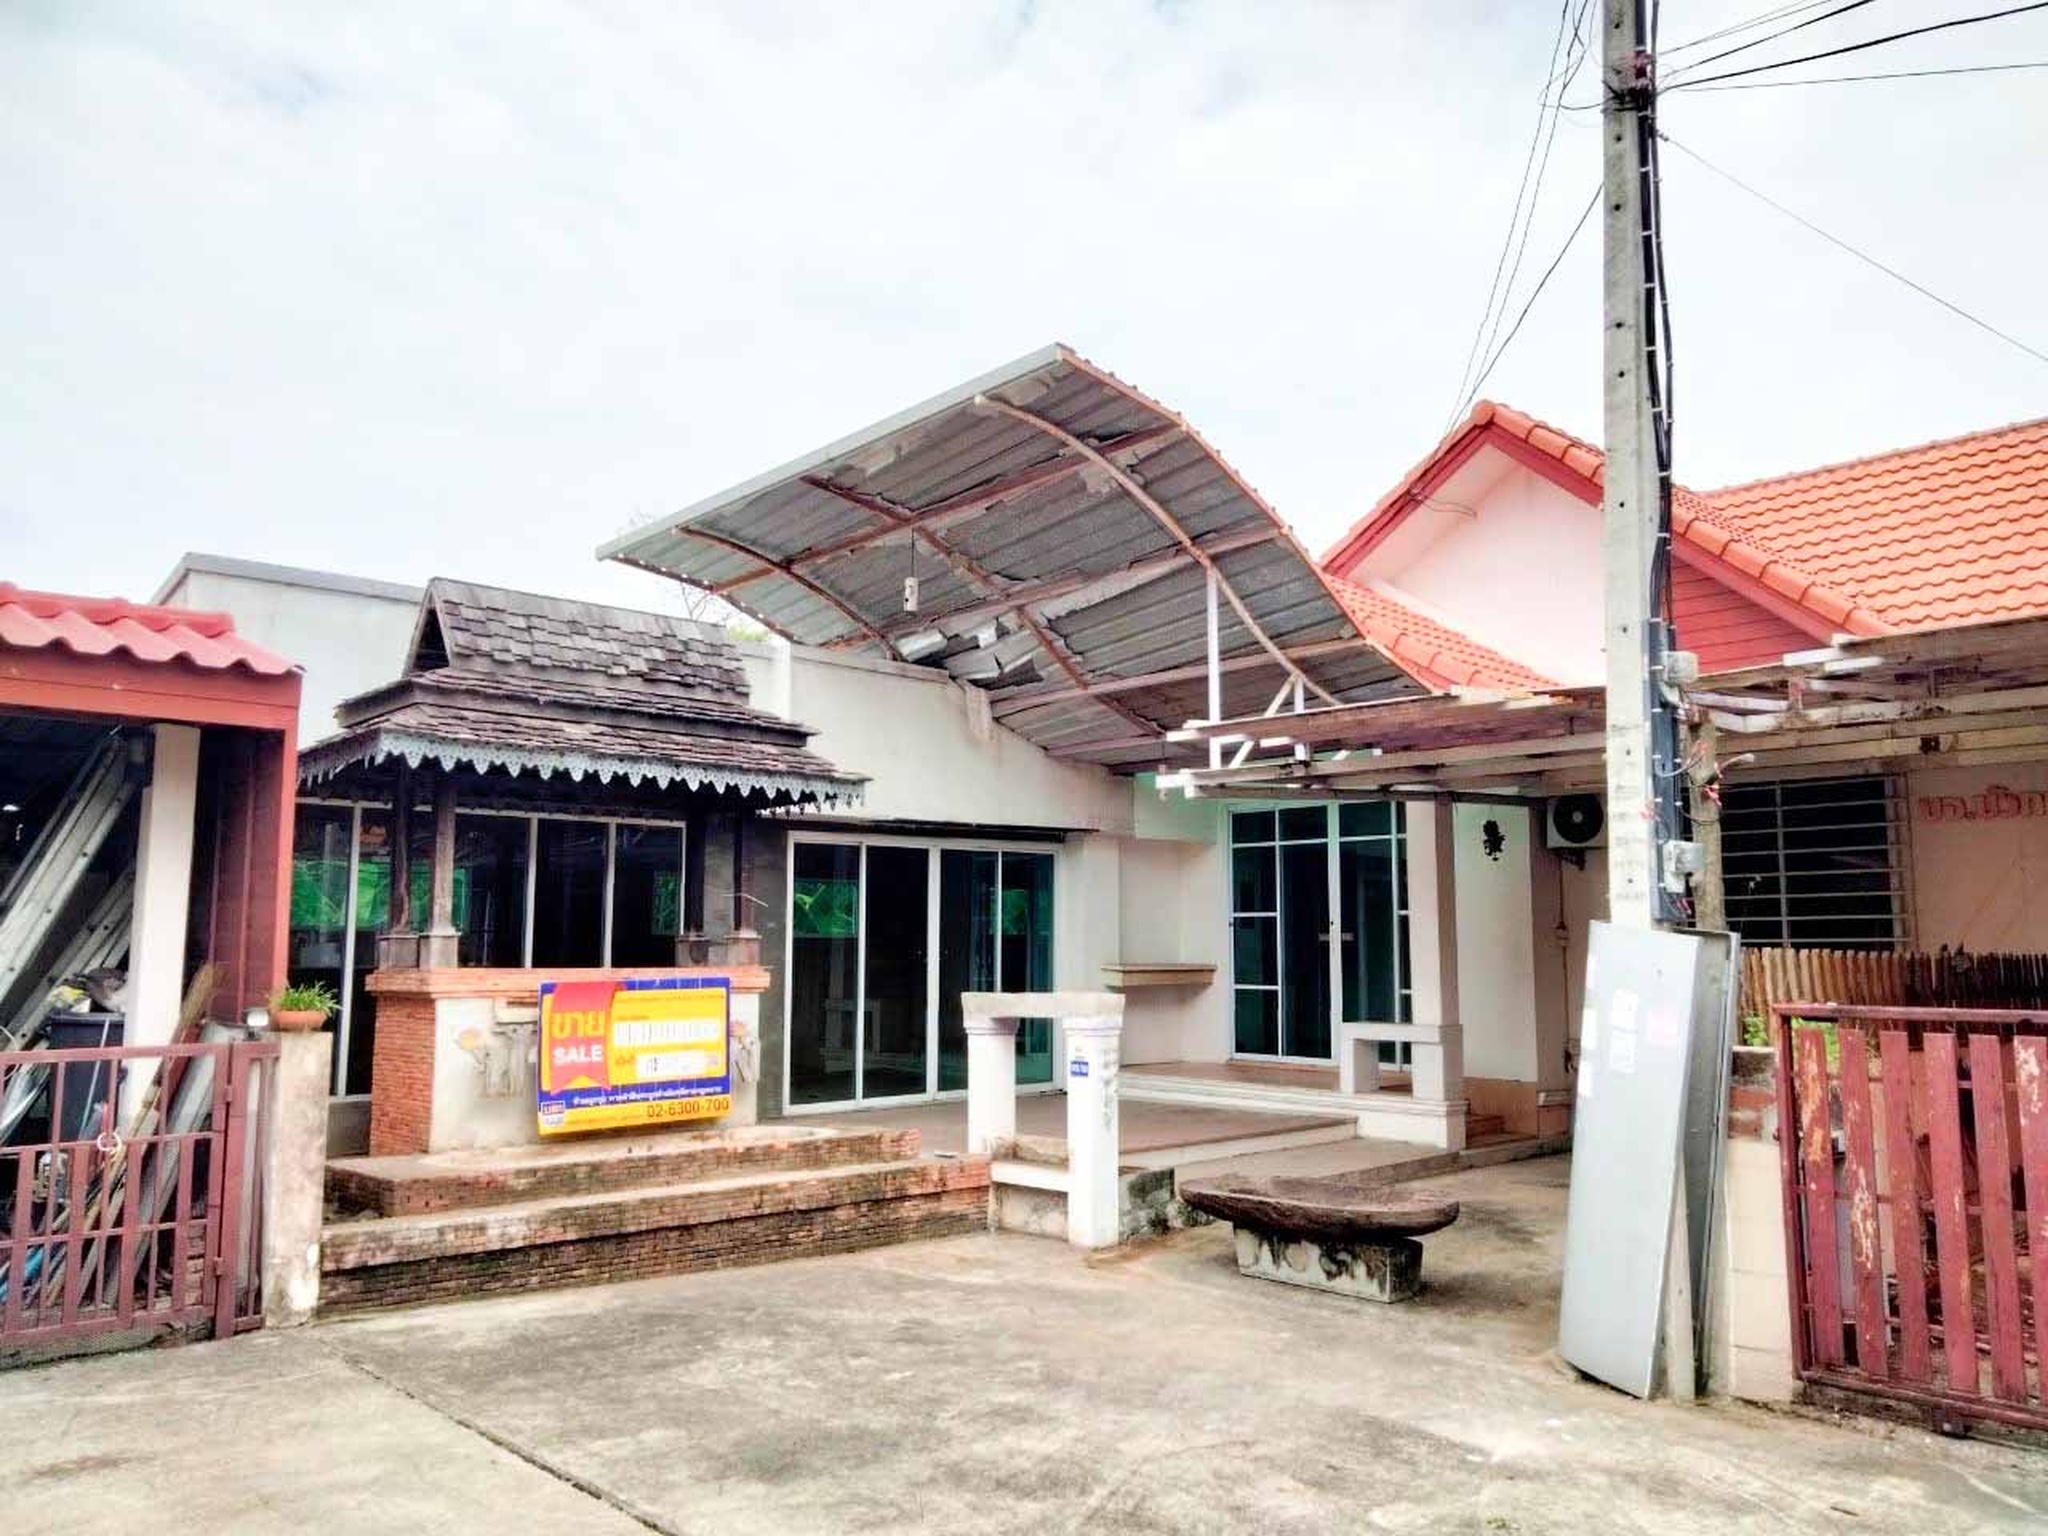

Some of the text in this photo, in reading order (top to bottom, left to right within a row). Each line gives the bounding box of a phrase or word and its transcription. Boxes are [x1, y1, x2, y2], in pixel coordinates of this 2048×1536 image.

[552, 1010, 606, 1039] ขาย
[553, 1044, 604, 1066] SALE
[646, 1098, 730, 1119] 02-6300-700
